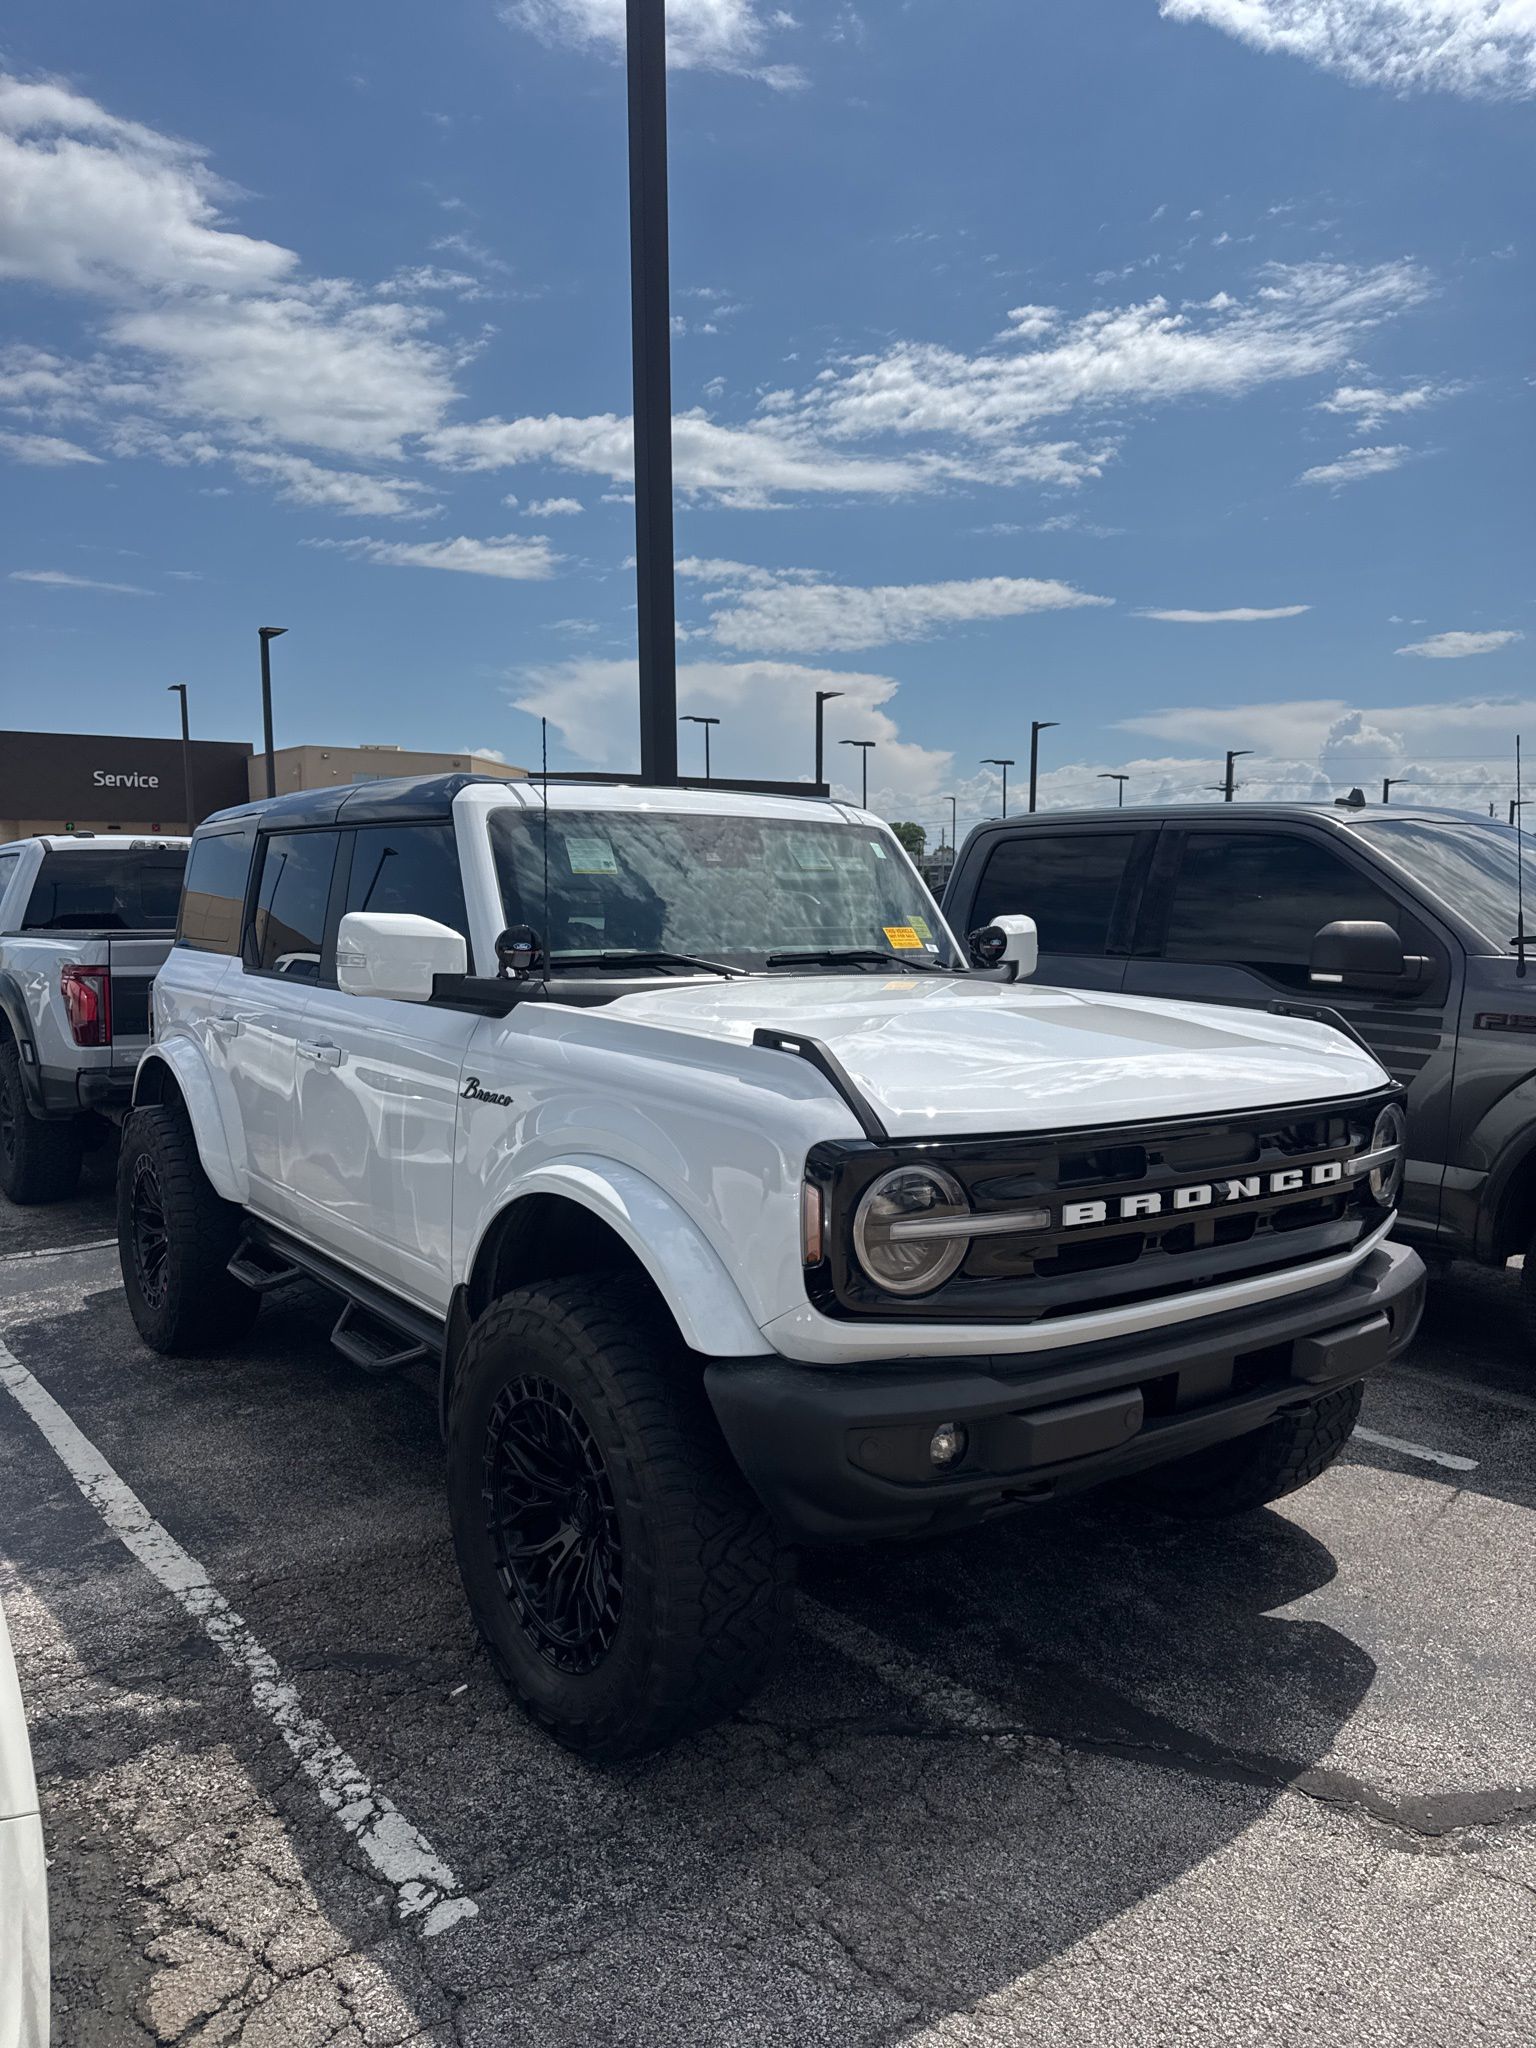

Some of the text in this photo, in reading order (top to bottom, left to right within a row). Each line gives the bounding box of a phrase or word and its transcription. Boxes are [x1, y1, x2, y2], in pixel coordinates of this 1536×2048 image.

[93, 770, 159, 788] Service
[460, 1076, 514, 1107] Bronco
[1062, 1162, 1341, 1226] BRONCO
